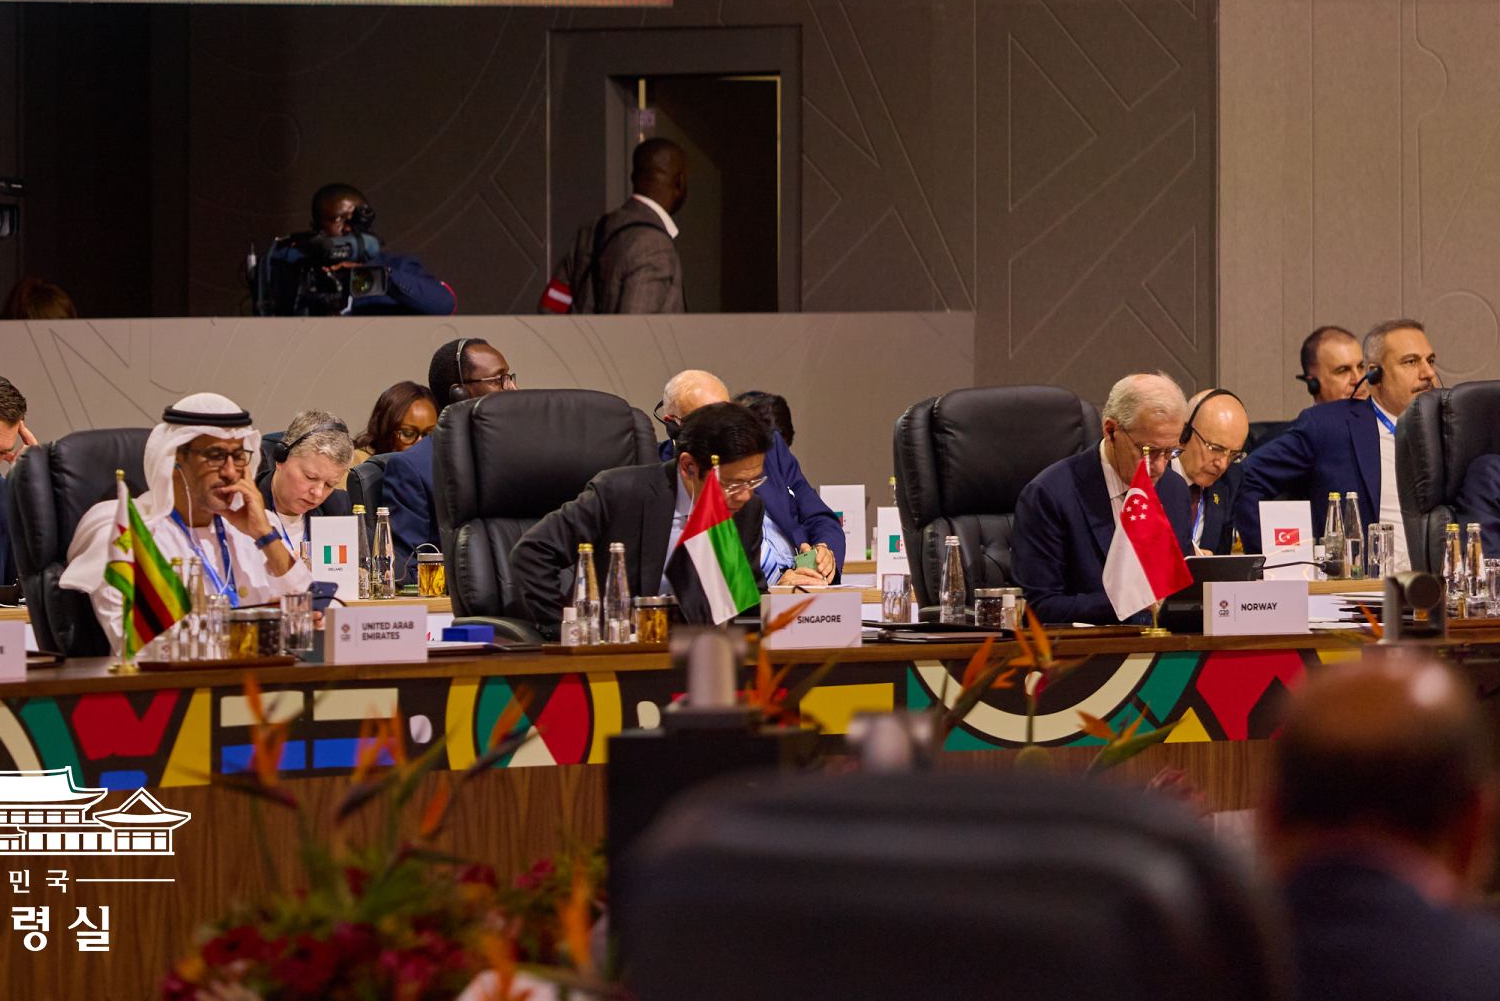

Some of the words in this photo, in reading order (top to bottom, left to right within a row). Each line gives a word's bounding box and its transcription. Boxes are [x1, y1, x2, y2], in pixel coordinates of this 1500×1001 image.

[1241, 602, 1278, 611] NORWAY
[797, 615, 842, 624] SINGAPORE
[362, 622, 391, 631] UNITED
[392, 621, 414, 630] ARAB
[362, 631, 400, 641] EMIRATES
